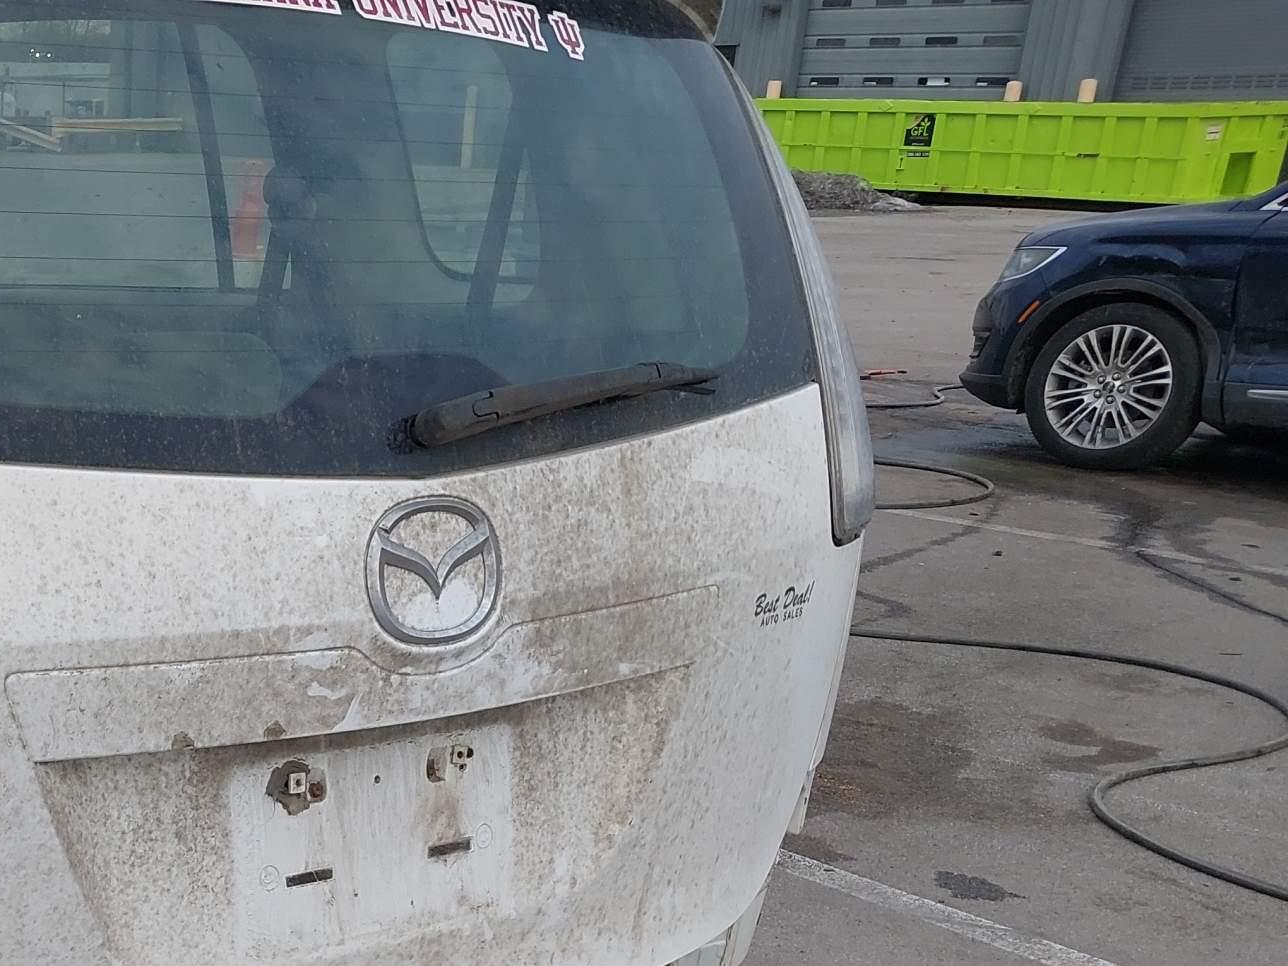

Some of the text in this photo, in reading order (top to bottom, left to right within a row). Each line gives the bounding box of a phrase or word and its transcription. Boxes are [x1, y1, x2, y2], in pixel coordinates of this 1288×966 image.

[911, 121, 930, 136] GFL
[755, 580, 815, 616] Best Deal!
[760, 607, 804, 627] AUTO SALES
